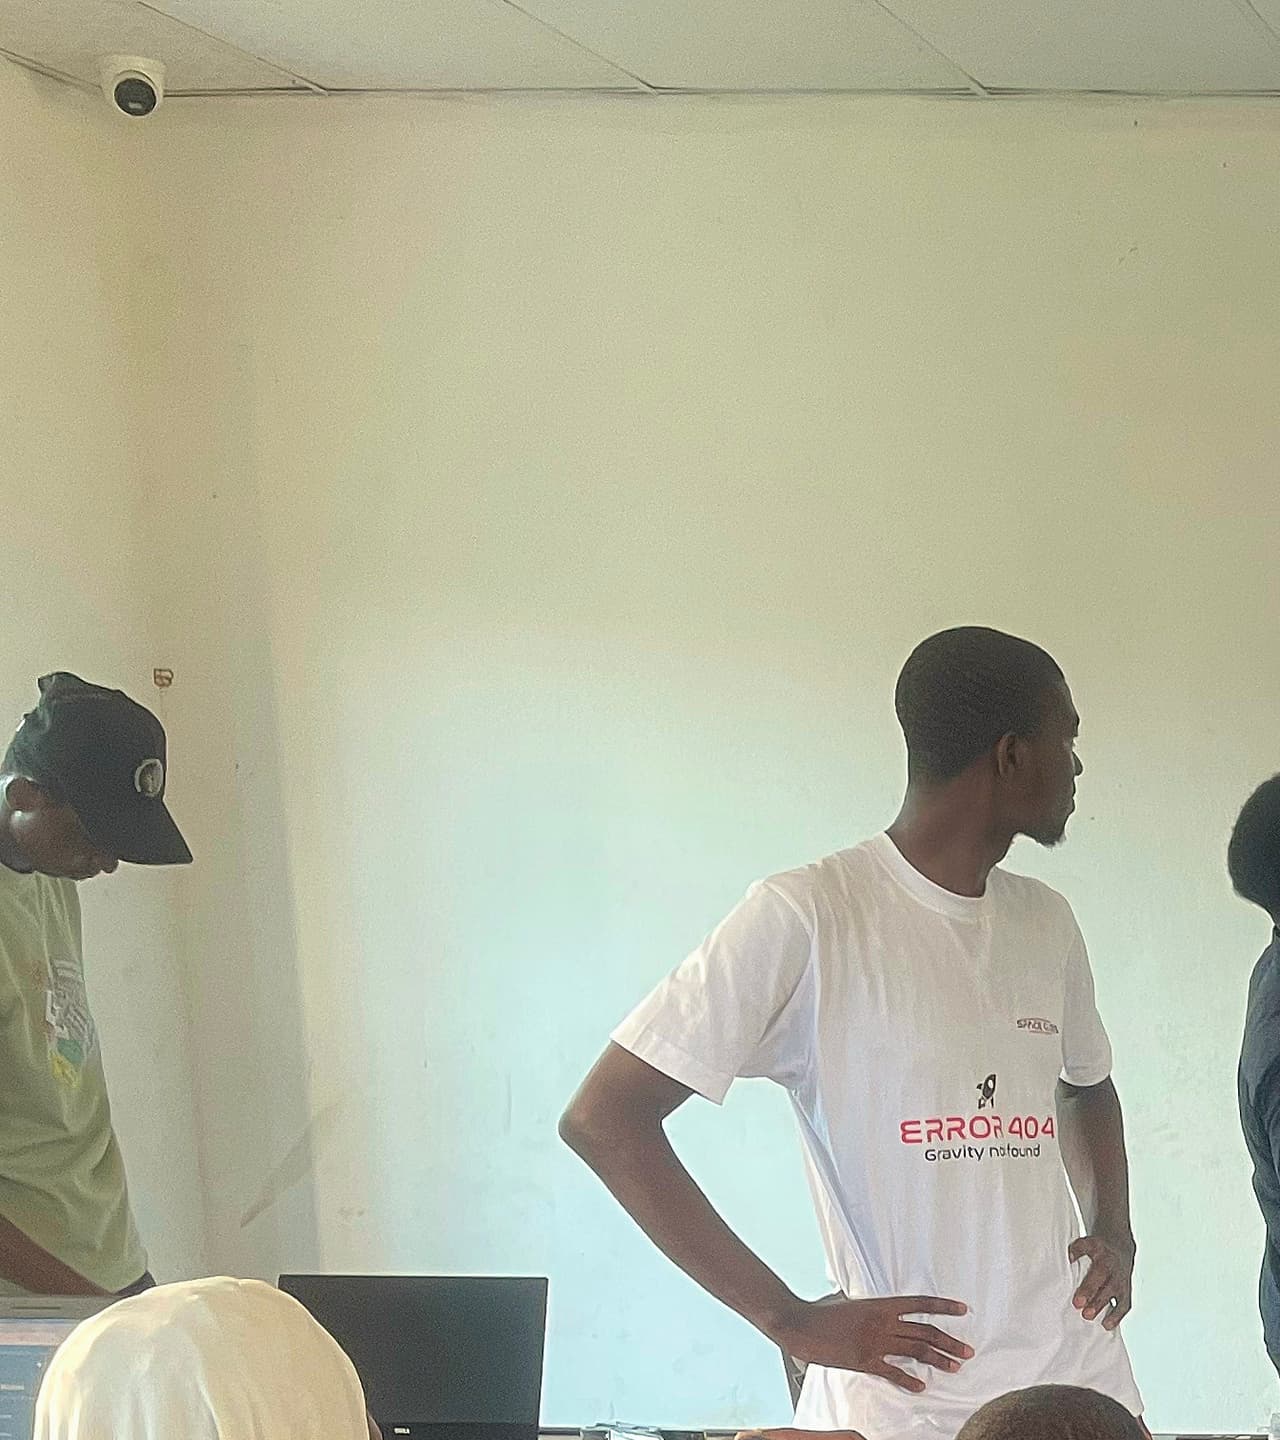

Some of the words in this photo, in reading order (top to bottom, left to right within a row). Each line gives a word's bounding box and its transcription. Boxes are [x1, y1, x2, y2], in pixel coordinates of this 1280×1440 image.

[900, 1115, 1004, 1144] ERROR
[1008, 1115, 1055, 1140] 404
[925, 1144, 985, 1162] Gravity
